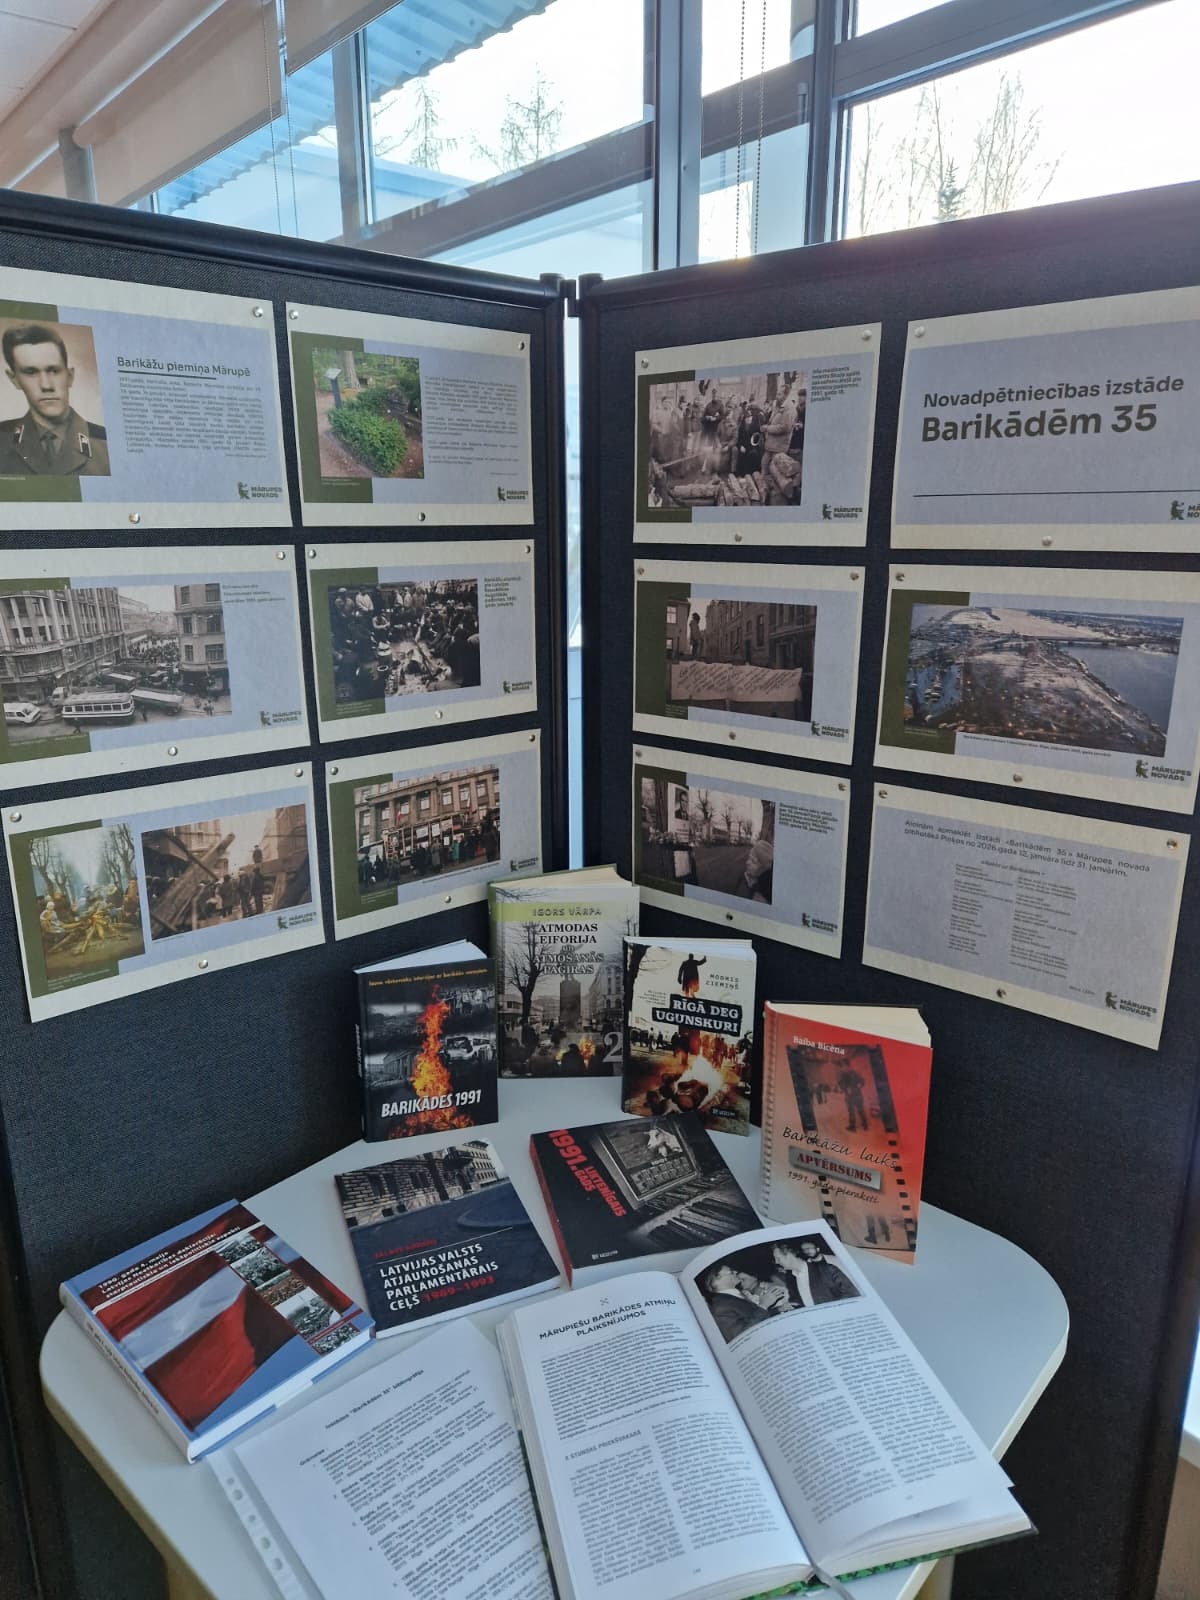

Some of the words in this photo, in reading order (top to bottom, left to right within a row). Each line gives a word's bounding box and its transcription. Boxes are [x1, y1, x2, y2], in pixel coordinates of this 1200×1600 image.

[117, 356, 164, 370] Barikāžu
[166, 361, 210, 375] piemiņa
[212, 365, 251, 378] Mārupē
[924, 383, 1100, 407] Novadpētniecības
[1105, 376, 1184, 396] izstāde
[922, 408, 1102, 442] Barikādēm
[1111, 404, 1157, 433] 35
[1150, 772, 1184, 782] NOVADS
[1151, 766, 1191, 777] MĀRUPES
[533, 908, 565, 916] IGORS
[539, 923, 598, 933] ATMODAS
[540, 935, 597, 944] EIFORIJA
[672, 999, 706, 1014] RĪGĀ
[710, 1005, 739, 1019] DEG
[1119, 1004, 1151, 1017] NOVADS
[655, 1010, 738, 1032] UGUNSKURI
[602, 1031, 623, 1063] 2
[381, 1093, 453, 1118] BARIKĀDES
[455, 1089, 481, 1107] 1991
[797, 1153, 872, 1182] APVĒRSUMS
[860, 1147, 898, 1169] laiks
[380, 1256, 437, 1278] LATVIJAS
[438, 1243, 483, 1263] VALSTS
[383, 1255, 479, 1289] ATJAUNOŠANAS
[386, 1261, 499, 1300] PARLAMENTĀRAIS
[389, 1296, 420, 1311] CEĻŠ
[539, 1318, 590, 1340] MĀRUPIEŠU
[592, 1302, 642, 1322] BARIKĀDES
[576, 1310, 647, 1337] PLAIKSNĪJUMOS
